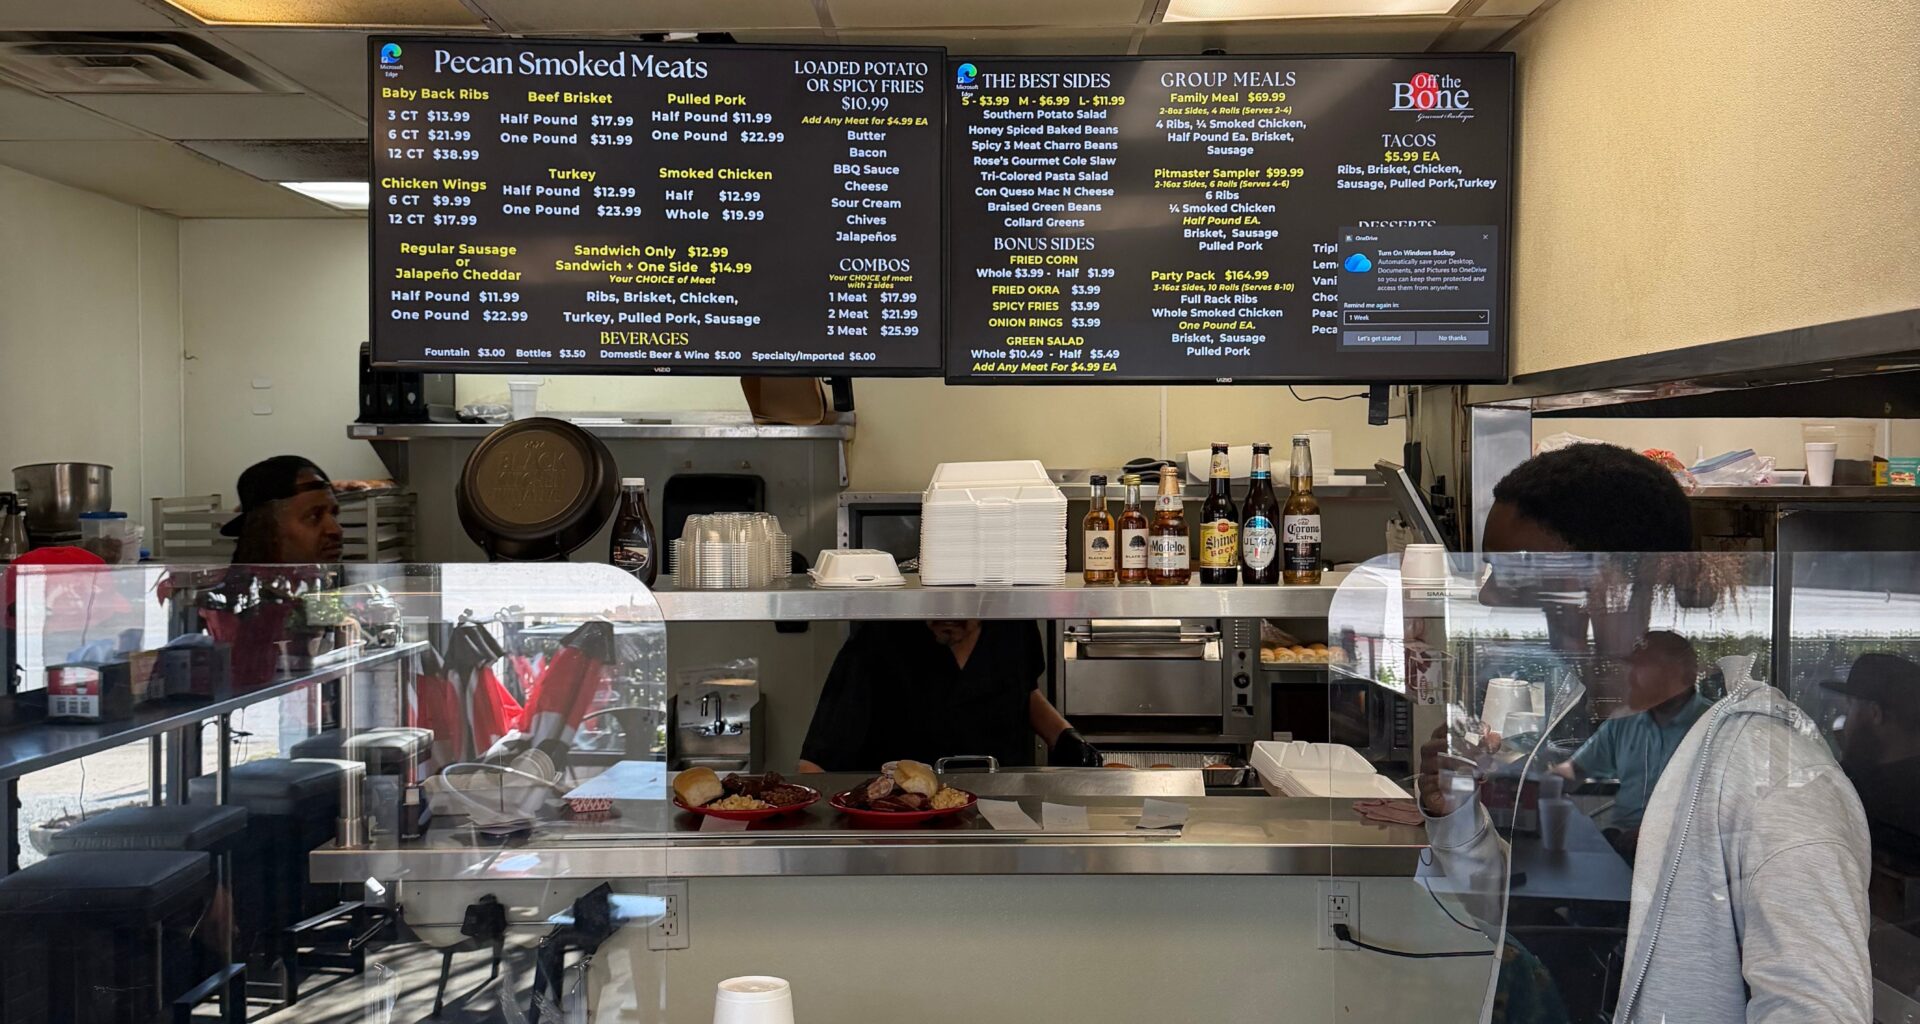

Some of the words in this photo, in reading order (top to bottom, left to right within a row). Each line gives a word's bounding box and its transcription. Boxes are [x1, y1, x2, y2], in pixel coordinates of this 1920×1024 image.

[435, 49, 514, 75] Pecan
[518, 49, 626, 77] Smoked
[630, 53, 708, 79] Meats
[795, 60, 861, 75] LOADED
[864, 61, 929, 76] POTATO
[806, 78, 830, 92] OR
[833, 78, 879, 93] SPICY
[881, 79, 925, 94] FRIES
[981, 73, 1016, 89] THE
[1019, 73, 1061, 89] BEST
[1062, 73, 1111, 89] SIDES
[1160, 71, 1228, 88] GROUP
[1233, 71, 1296, 87] MEALS
[1413, 72, 1440, 90] Off
[1441, 73, 1462, 89] the
[382, 87, 417, 101] Baby
[421, 87, 456, 100] Back
[459, 88, 489, 100] Ribs
[527, 91, 561, 103] Beef
[563, 91, 613, 104] Brisket
[667, 93, 711, 105] Pulled
[714, 94, 747, 106] Pork
[1170, 91, 1209, 105] Family
[1211, 92, 1239, 103] Meal
[1247, 91, 1286, 104] $69.99
[1391, 82, 1471, 110] Bone
[841, 95, 889, 111] $10.99
[387, 109, 397, 121] 3
[400, 110, 419, 121] CT
[427, 109, 471, 123] $13.99
[500, 113, 529, 125] Half
[533, 113, 578, 126] Pound
[591, 114, 634, 127] $17.99
[983, 109, 1035, 120] Southern
[1036, 109, 1075, 119] Potato
[1076, 109, 1107, 119] Salad
[847, 130, 887, 141] Butter
[968, 125, 1005, 137] Honey
[1006, 124, 1044, 137] Spiced
[1046, 124, 1082, 135] Baked
[1084, 125, 1119, 135] Beans
[1167, 131, 1191, 142] Half
[1193, 131, 1229, 142] Pound
[1231, 131, 1249, 142] Ea.
[1251, 131, 1295, 143] Brisket,
[499, 132, 529, 144] One
[533, 133, 578, 145] Pound
[590, 133, 633, 146] $31.99
[1381, 133, 1437, 148] TACOS
[387, 147, 403, 159] 12
[406, 148, 425, 159] CT
[433, 147, 480, 161] $38.99
[849, 147, 887, 158] Bacon
[1384, 150, 1419, 163] $5.99
[1422, 151, 1441, 162] EA
[973, 155, 1009, 166] Rose's
[1011, 155, 1061, 166] Gourmet
[1062, 155, 1088, 166] Cole
[1089, 155, 1117, 166] Slaw
[548, 168, 597, 183] Turkey
[659, 167, 714, 179] Smoked
[717, 167, 773, 180] Chicken
[833, 163, 861, 177] BBQ
[863, 164, 900, 175] Sauce
[980, 170, 1043, 181] Tri-Colored
[1044, 171, 1076, 181] Pasta
[1077, 170, 1109, 181] Salad
[1154, 167, 1211, 178] Pitmaster
[1212, 167, 1261, 180] Sampler
[1265, 166, 1305, 179] $99.99
[1337, 163, 1365, 176] Ribs,
[1367, 163, 1411, 176] Brisket,
[1412, 163, 1463, 175] Chicken,
[381, 177, 439, 189] Chicken
[442, 177, 487, 193] Wings
[844, 180, 889, 192] Cheese
[665, 208, 710, 220] Whole
[721, 208, 765, 221] $19.99
[1003, 217, 1044, 227] Collard
[1045, 217, 1086, 228] Greens
[835, 231, 897, 244] Jalapeños
[994, 237, 1048, 251] BONUS
[1050, 237, 1095, 251] SIDES
[400, 242, 455, 256] Regular
[458, 243, 517, 258] Sausage
[574, 244, 641, 257] Sandwich
[644, 245, 677, 260] Only
[687, 245, 729, 259] $12.99
[455, 258, 471, 267] or
[839, 258, 910, 273] COMBOS
[1009, 255, 1044, 265] FRIED
[1045, 255, 1079, 265] CORN
[395, 267, 459, 282] Jalapeño
[462, 268, 523, 281] Cheddar
[609, 274, 634, 283] Your
[635, 274, 675, 284] CHOICE
[677, 275, 689, 284] of
[689, 275, 716, 285] Meat
[1151, 270, 1184, 283] Party
[1185, 269, 1216, 281] Pack
[1224, 269, 1270, 282] $164.99
[991, 285, 1026, 295] FRIED
[1027, 285, 1061, 295] OKRA
[1071, 284, 1101, 296] $3.99
[828, 291, 834, 302] 1
[837, 291, 868, 303] Meat
[880, 291, 917, 304] $17.99
[1180, 294, 1201, 304] Full
[1203, 293, 1232, 304] Rack
[1233, 293, 1259, 304] Ribs
[391, 309, 420, 320] One
[424, 309, 470, 321] Pound
[482, 309, 529, 323] $22.99
[562, 311, 615, 325] Turkey,
[618, 311, 662, 324] Pulled
[665, 312, 701, 326] Pork,
[704, 313, 761, 327] Sausage
[988, 317, 1026, 327] ONION
[1029, 317, 1063, 328] RINGS
[1071, 317, 1101, 329] $3.99
[600, 331, 689, 346] BEVERAGES
[424, 347, 471, 357] Fountain
[477, 347, 506, 358] $3.00
[515, 348, 553, 358] Bottles
[559, 348, 587, 359] $3.50
[599, 349, 647, 359] Domestic
[649, 350, 673, 359] Beer
[683, 349, 710, 360] Wine
[714, 350, 742, 361] $5.00
[751, 350, 845, 363] Specialty/Imported
[849, 351, 877, 362] $6.00
[1205, 532, 1238, 550] Shiner
[1243, 537, 1275, 546] ULTRA
[1210, 545, 1235, 557] BOCK
